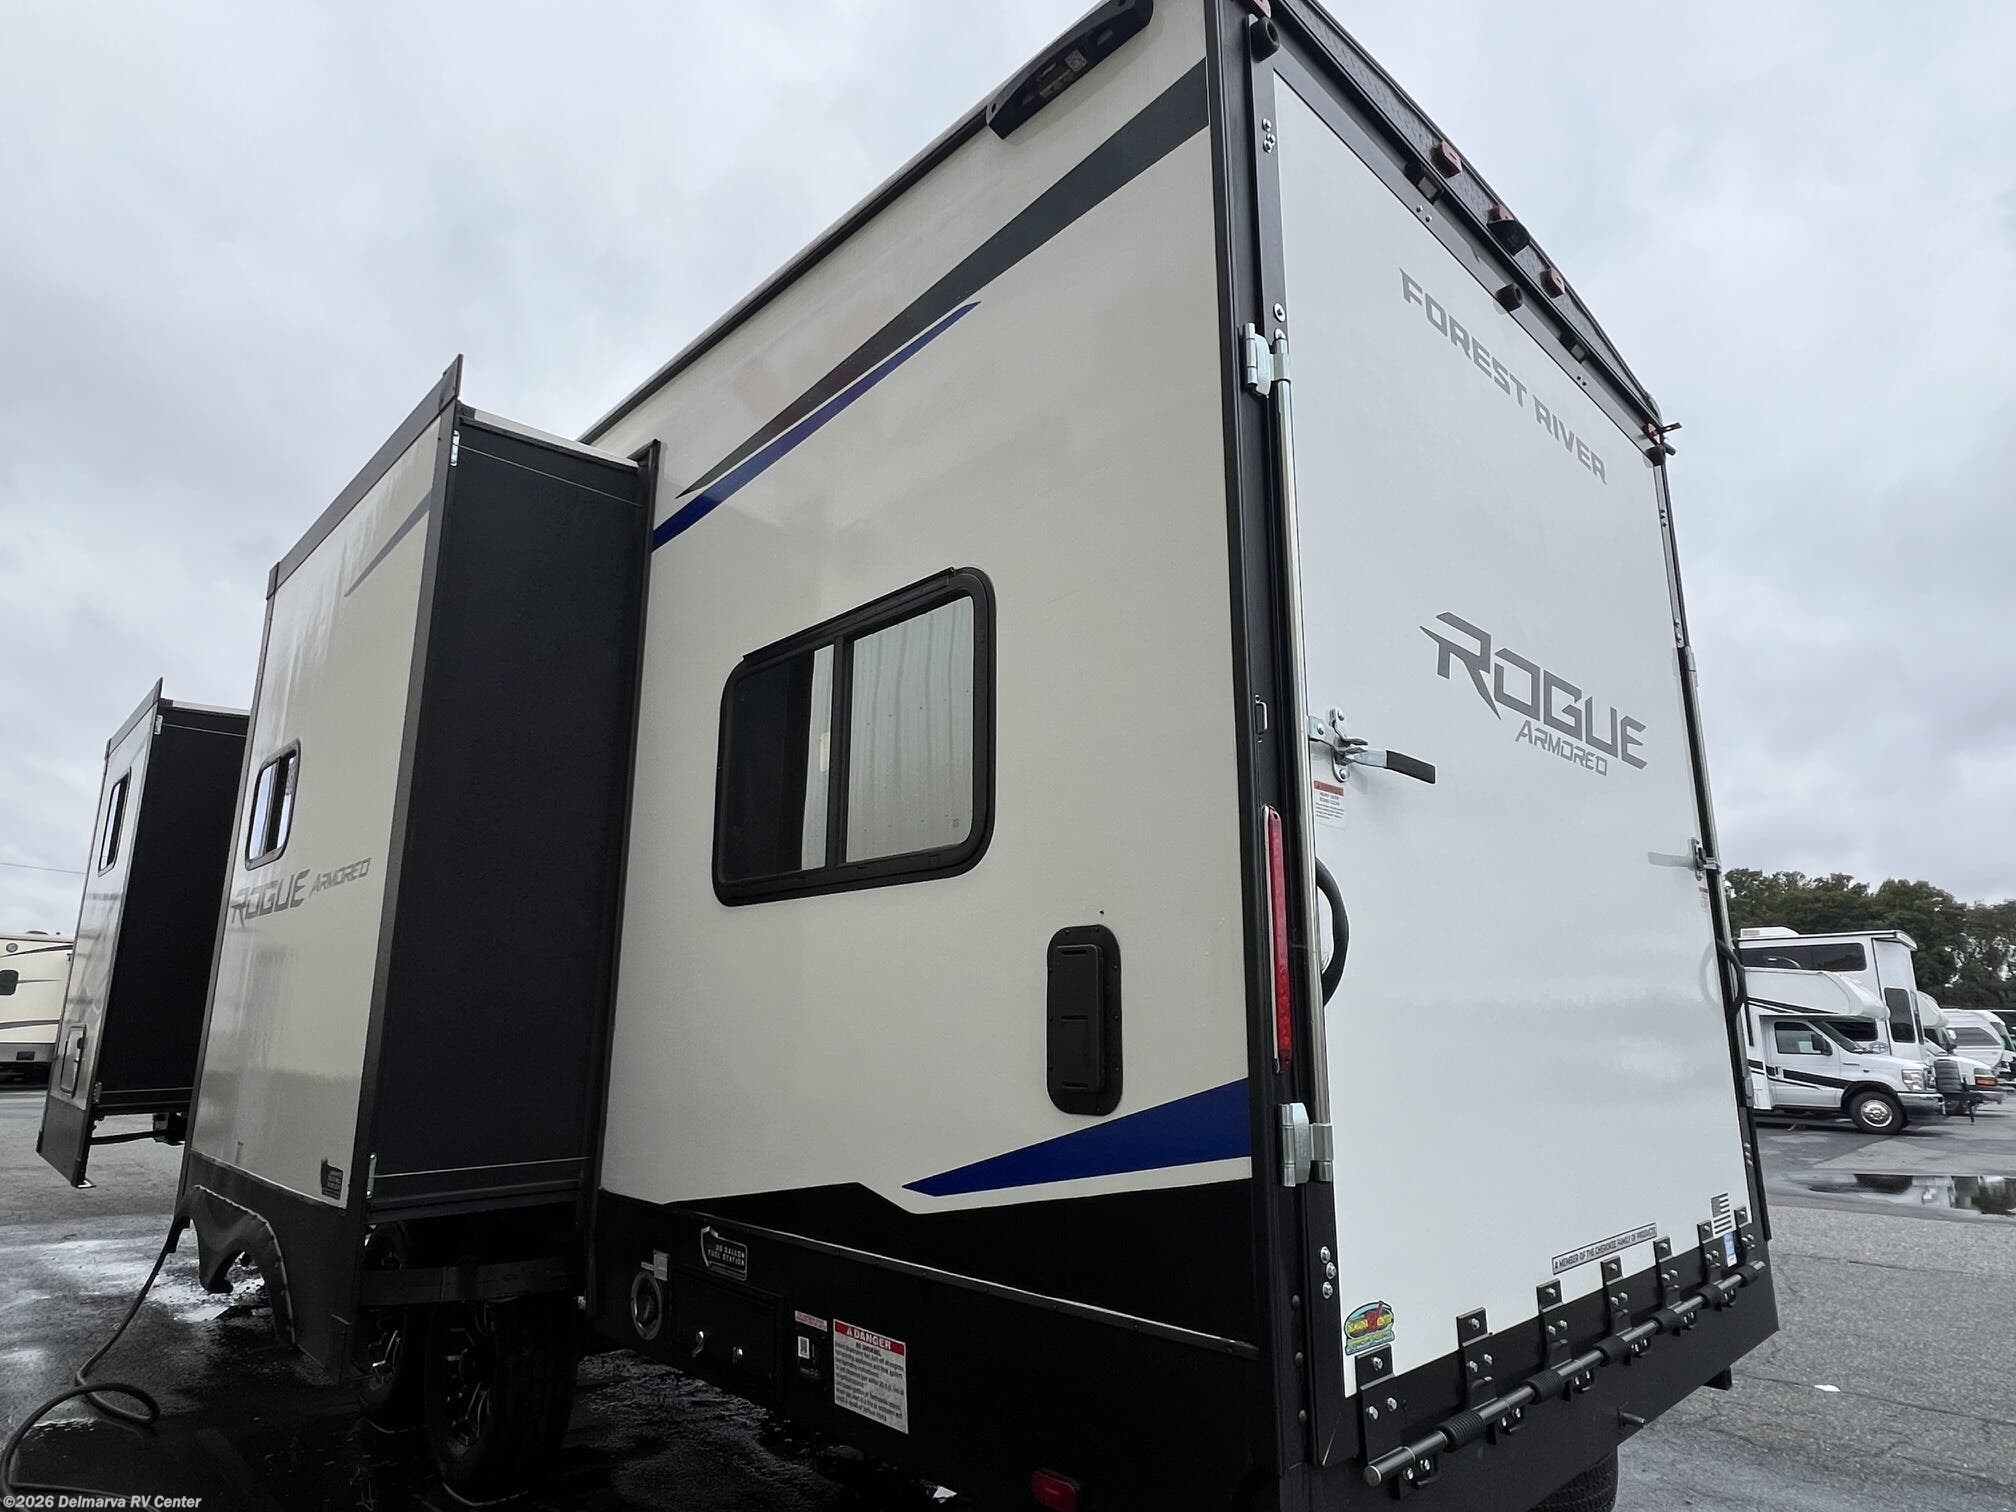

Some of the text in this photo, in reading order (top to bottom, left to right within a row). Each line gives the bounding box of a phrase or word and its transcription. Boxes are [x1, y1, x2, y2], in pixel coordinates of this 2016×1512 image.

[1399, 267, 1607, 485] FOREST RIVER
[1419, 611, 1648, 770] ROGUE
[1515, 719, 1607, 777] ARMORED
[231, 857, 373, 929] ROGUE ARMORED
[853, 1328, 891, 1350] DANGER
